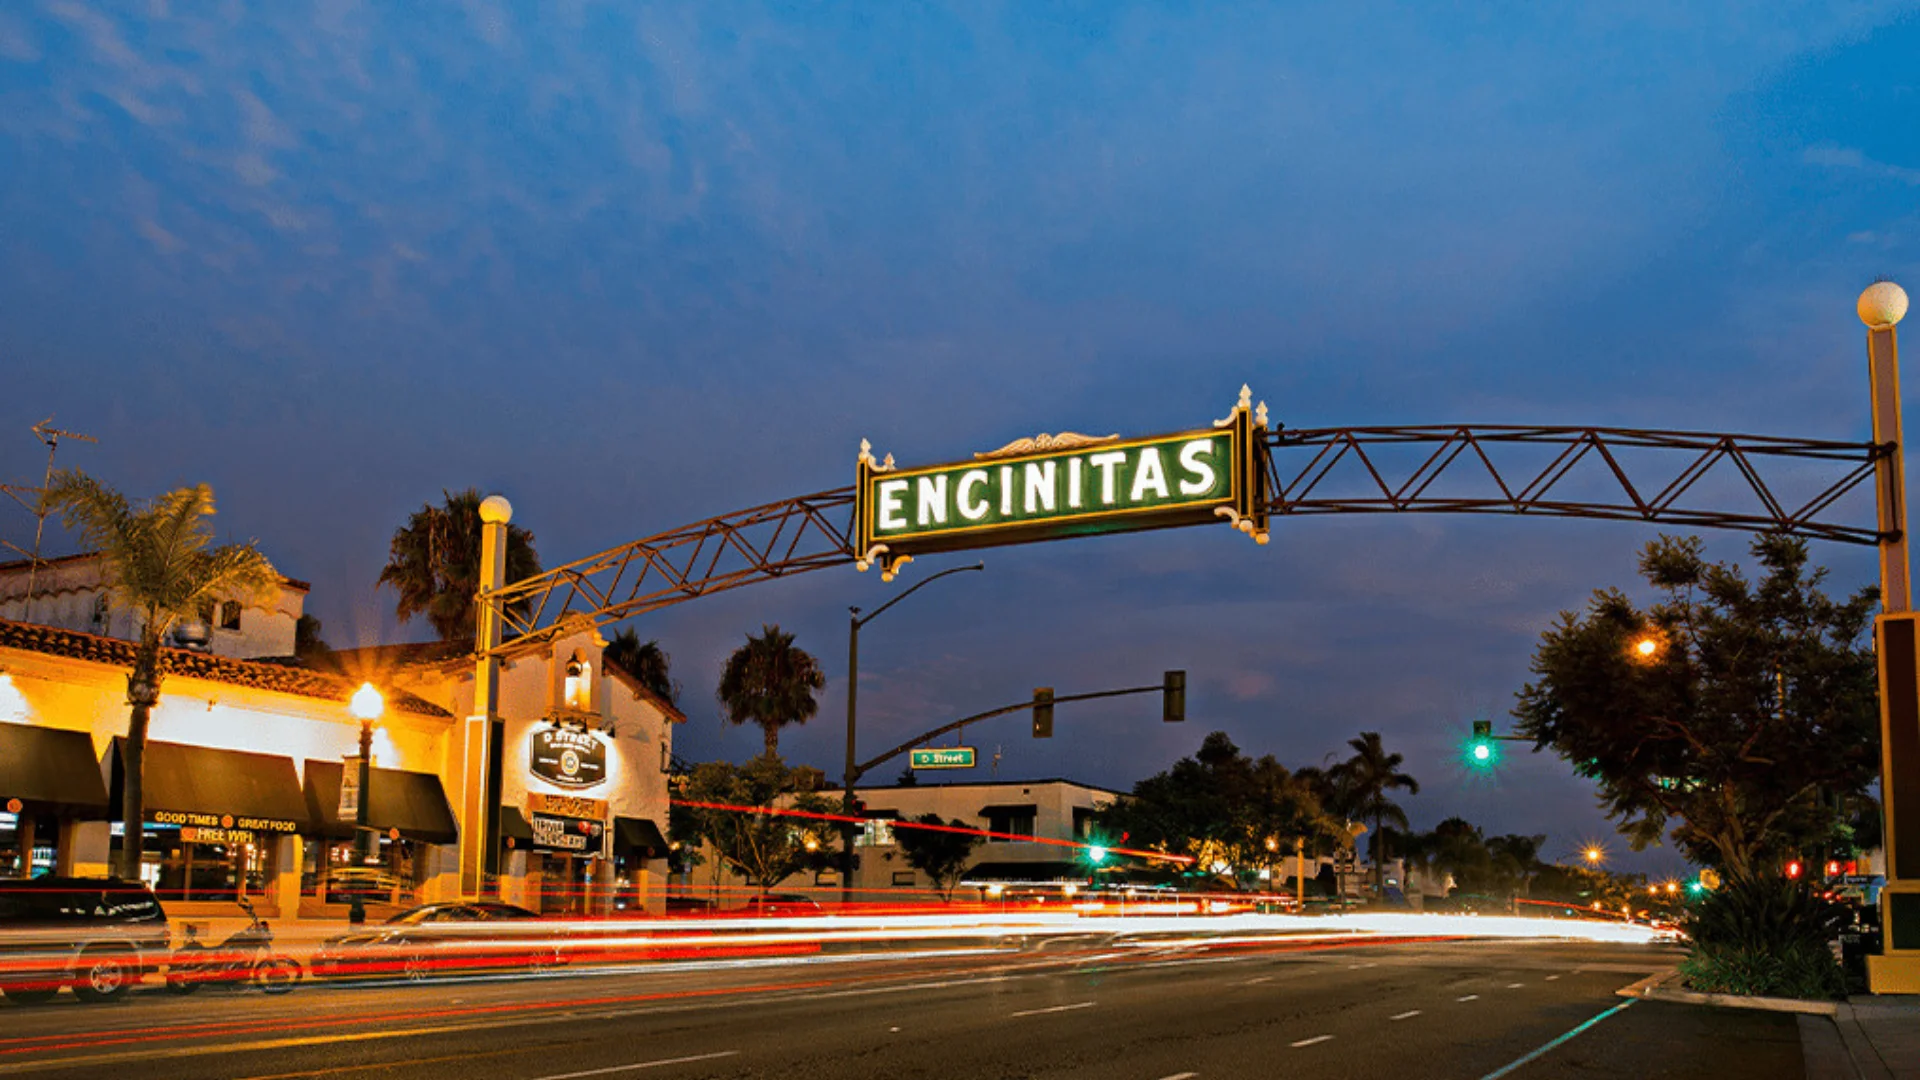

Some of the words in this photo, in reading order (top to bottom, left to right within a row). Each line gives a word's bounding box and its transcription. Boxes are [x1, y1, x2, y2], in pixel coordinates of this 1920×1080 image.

[878, 437, 1217, 530] ENCINITAS
[544, 732, 552, 742] D
[556, 730, 598, 750] STREET
[921, 754, 929, 763] D
[933, 753, 964, 764] Street
[155, 811, 187, 824] GOOD
[188, 814, 218, 826] TIMES
[238, 817, 269, 830] GREAT
[270, 820, 296, 832] FOOD
[198, 826, 225, 841] FREE
